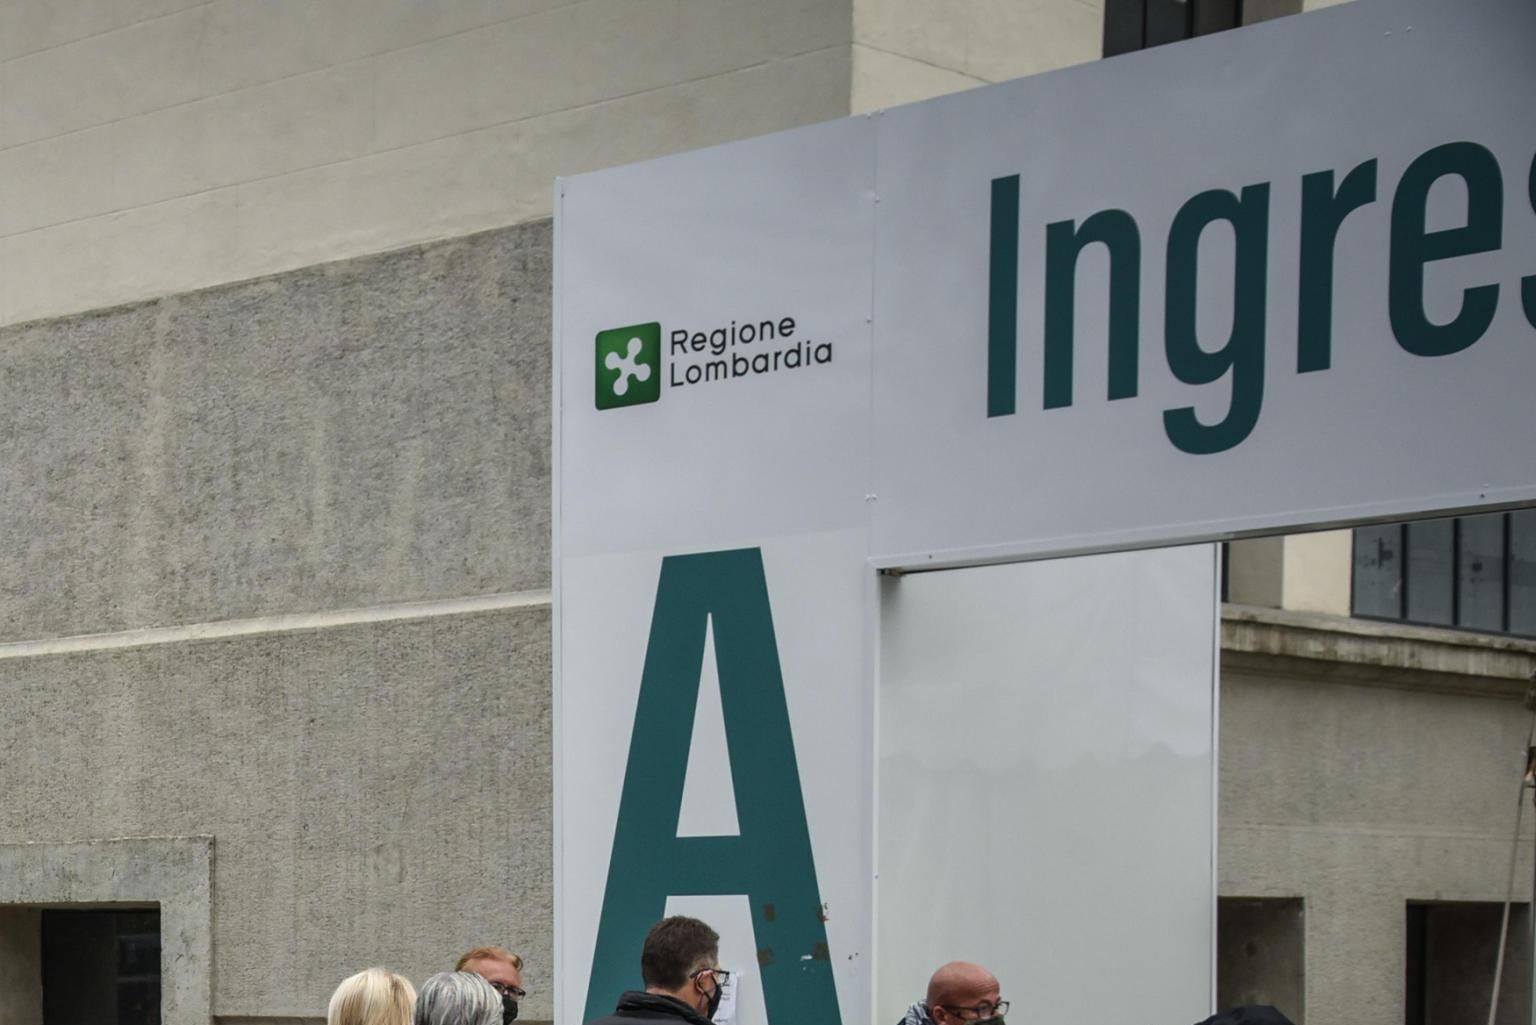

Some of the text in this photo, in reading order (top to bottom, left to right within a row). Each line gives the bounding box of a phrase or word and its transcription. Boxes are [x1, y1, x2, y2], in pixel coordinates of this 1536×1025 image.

[987, 141, 1536, 455] Ingre
[671, 317, 796, 356] Regione
[671, 341, 833, 387] Lombardia
